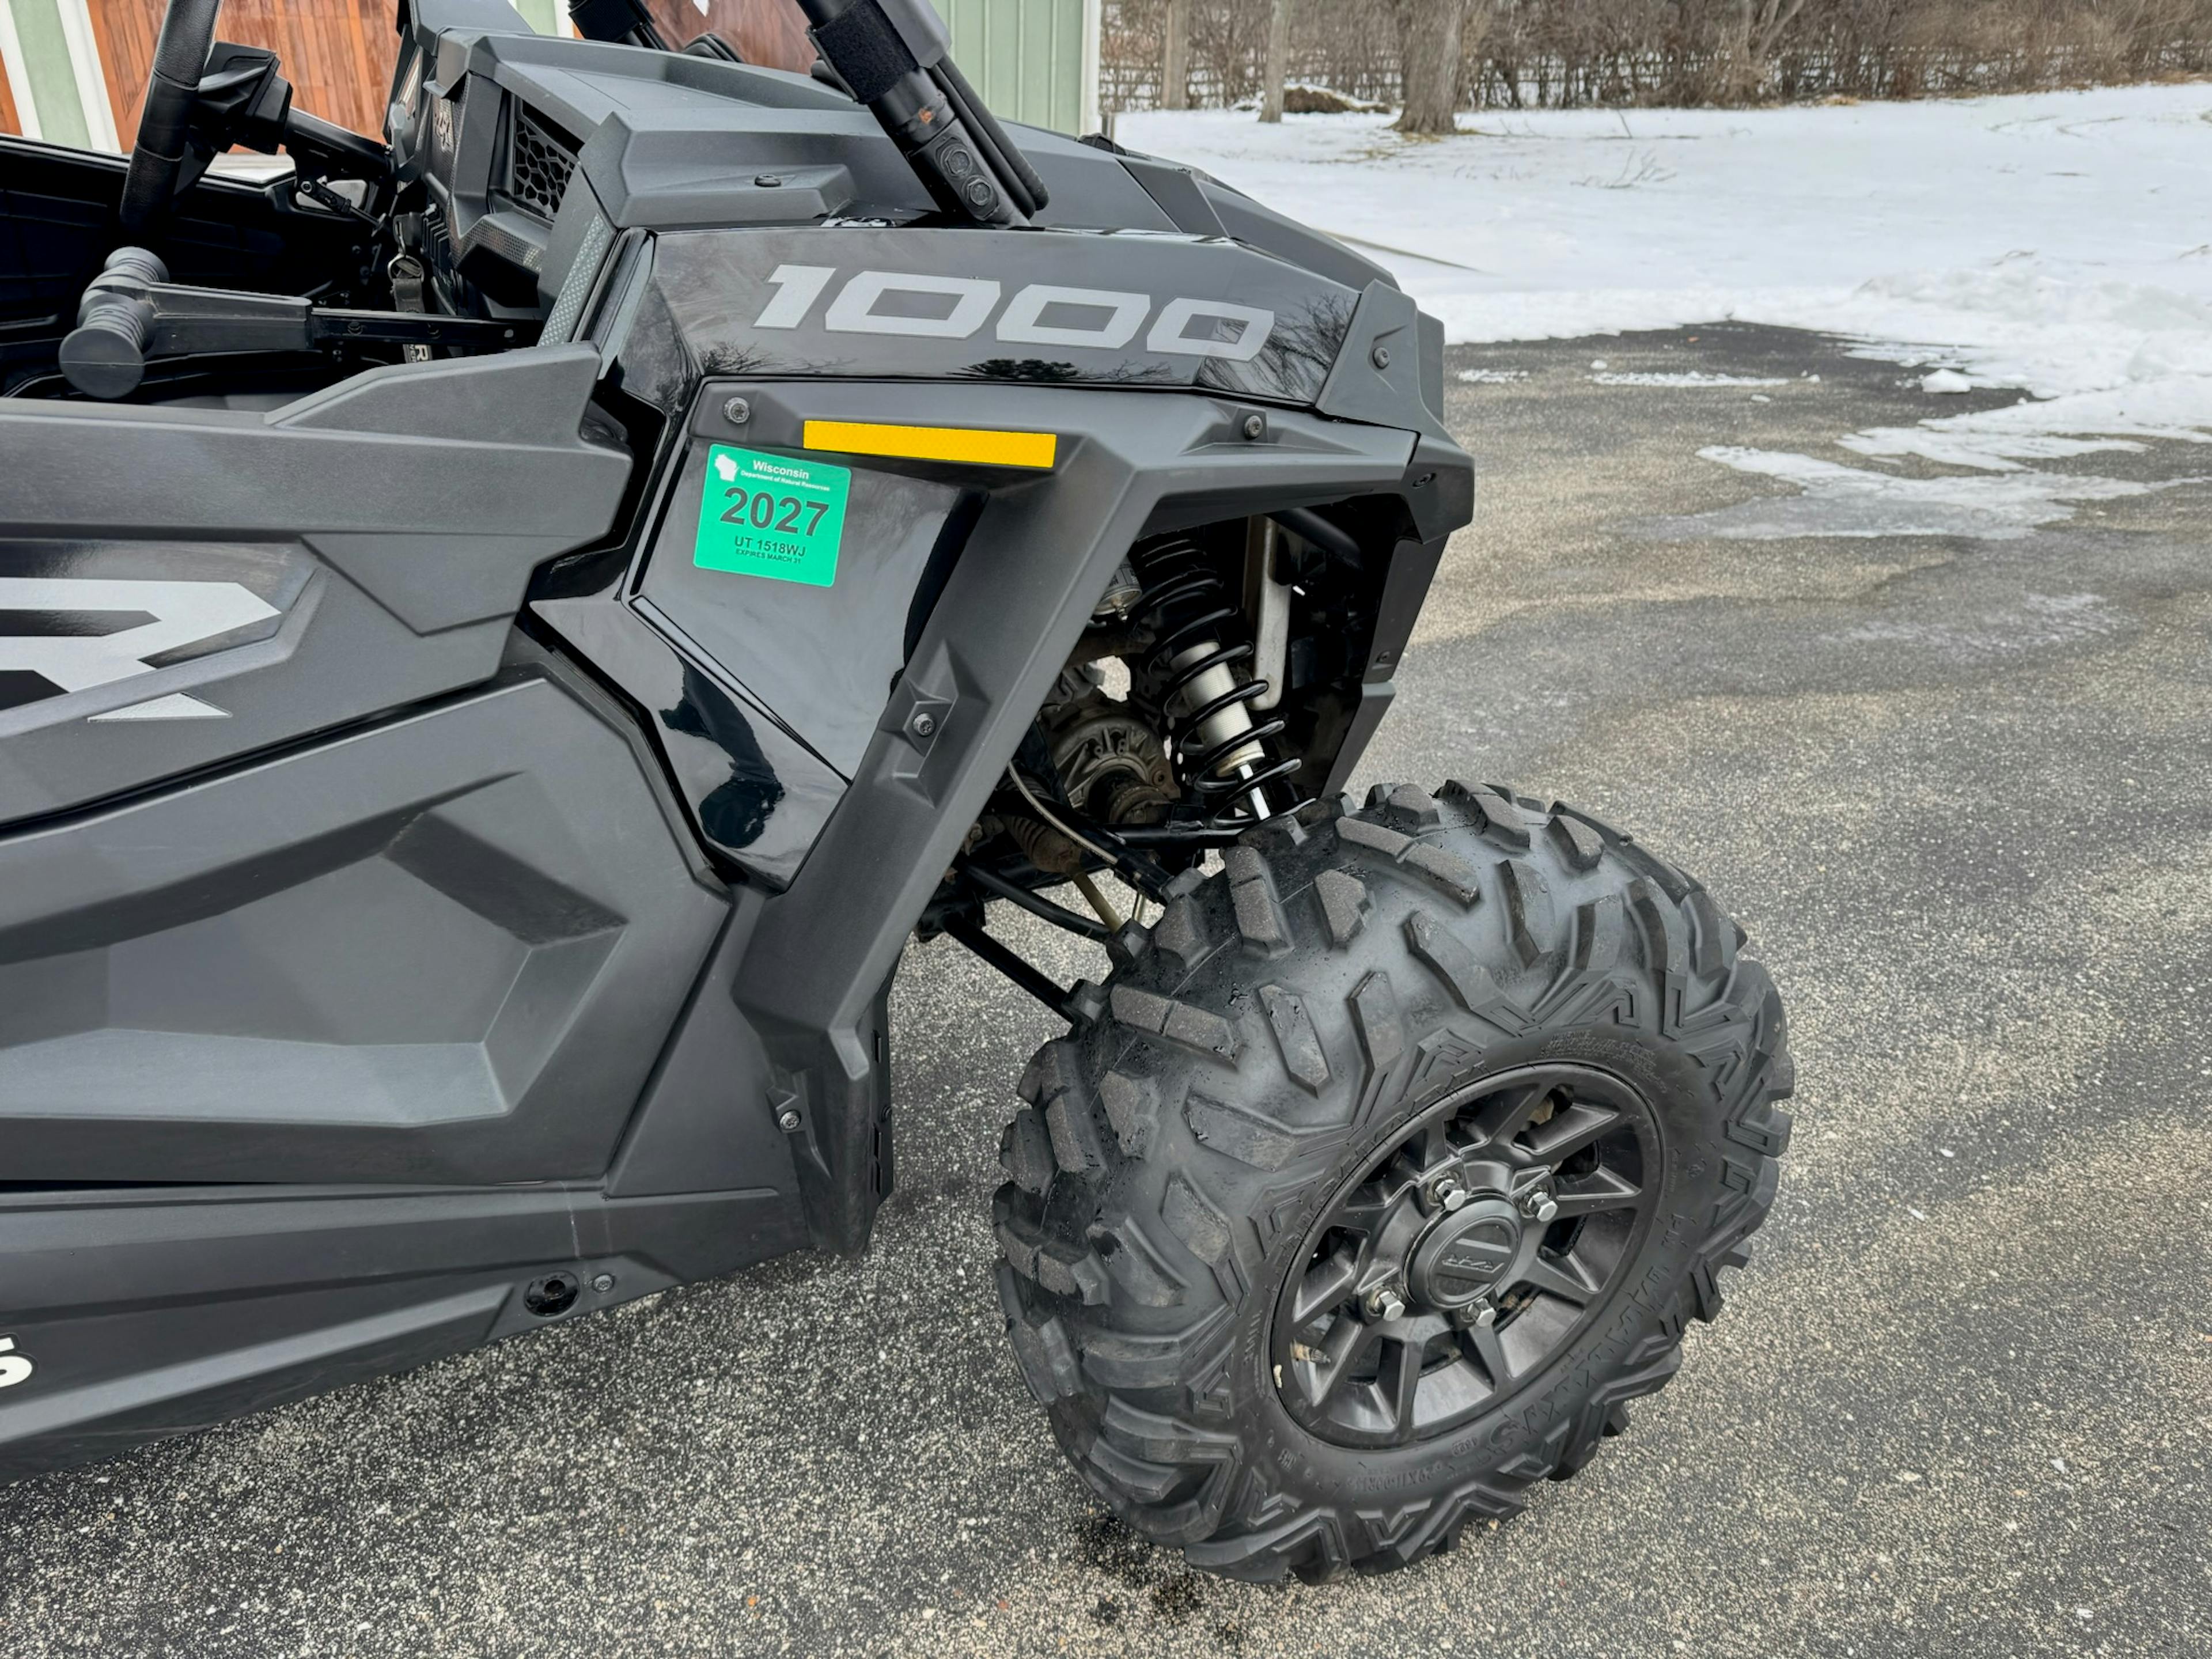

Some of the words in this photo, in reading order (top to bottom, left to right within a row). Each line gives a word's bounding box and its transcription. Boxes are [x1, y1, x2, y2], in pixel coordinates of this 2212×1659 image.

[752, 264, 1275, 362] 1000
[753, 460, 809, 479] Wisconsin
[740, 470, 773, 482] Department
[781, 477, 801, 487] Natural
[801, 482, 830, 491] Resources
[719, 487, 830, 537] 2027
[734, 536, 753, 548] UT
[757, 540, 806, 557] 1518WJ
[736, 548, 766, 559] EXPIRES
[767, 554, 793, 563] MARCH
